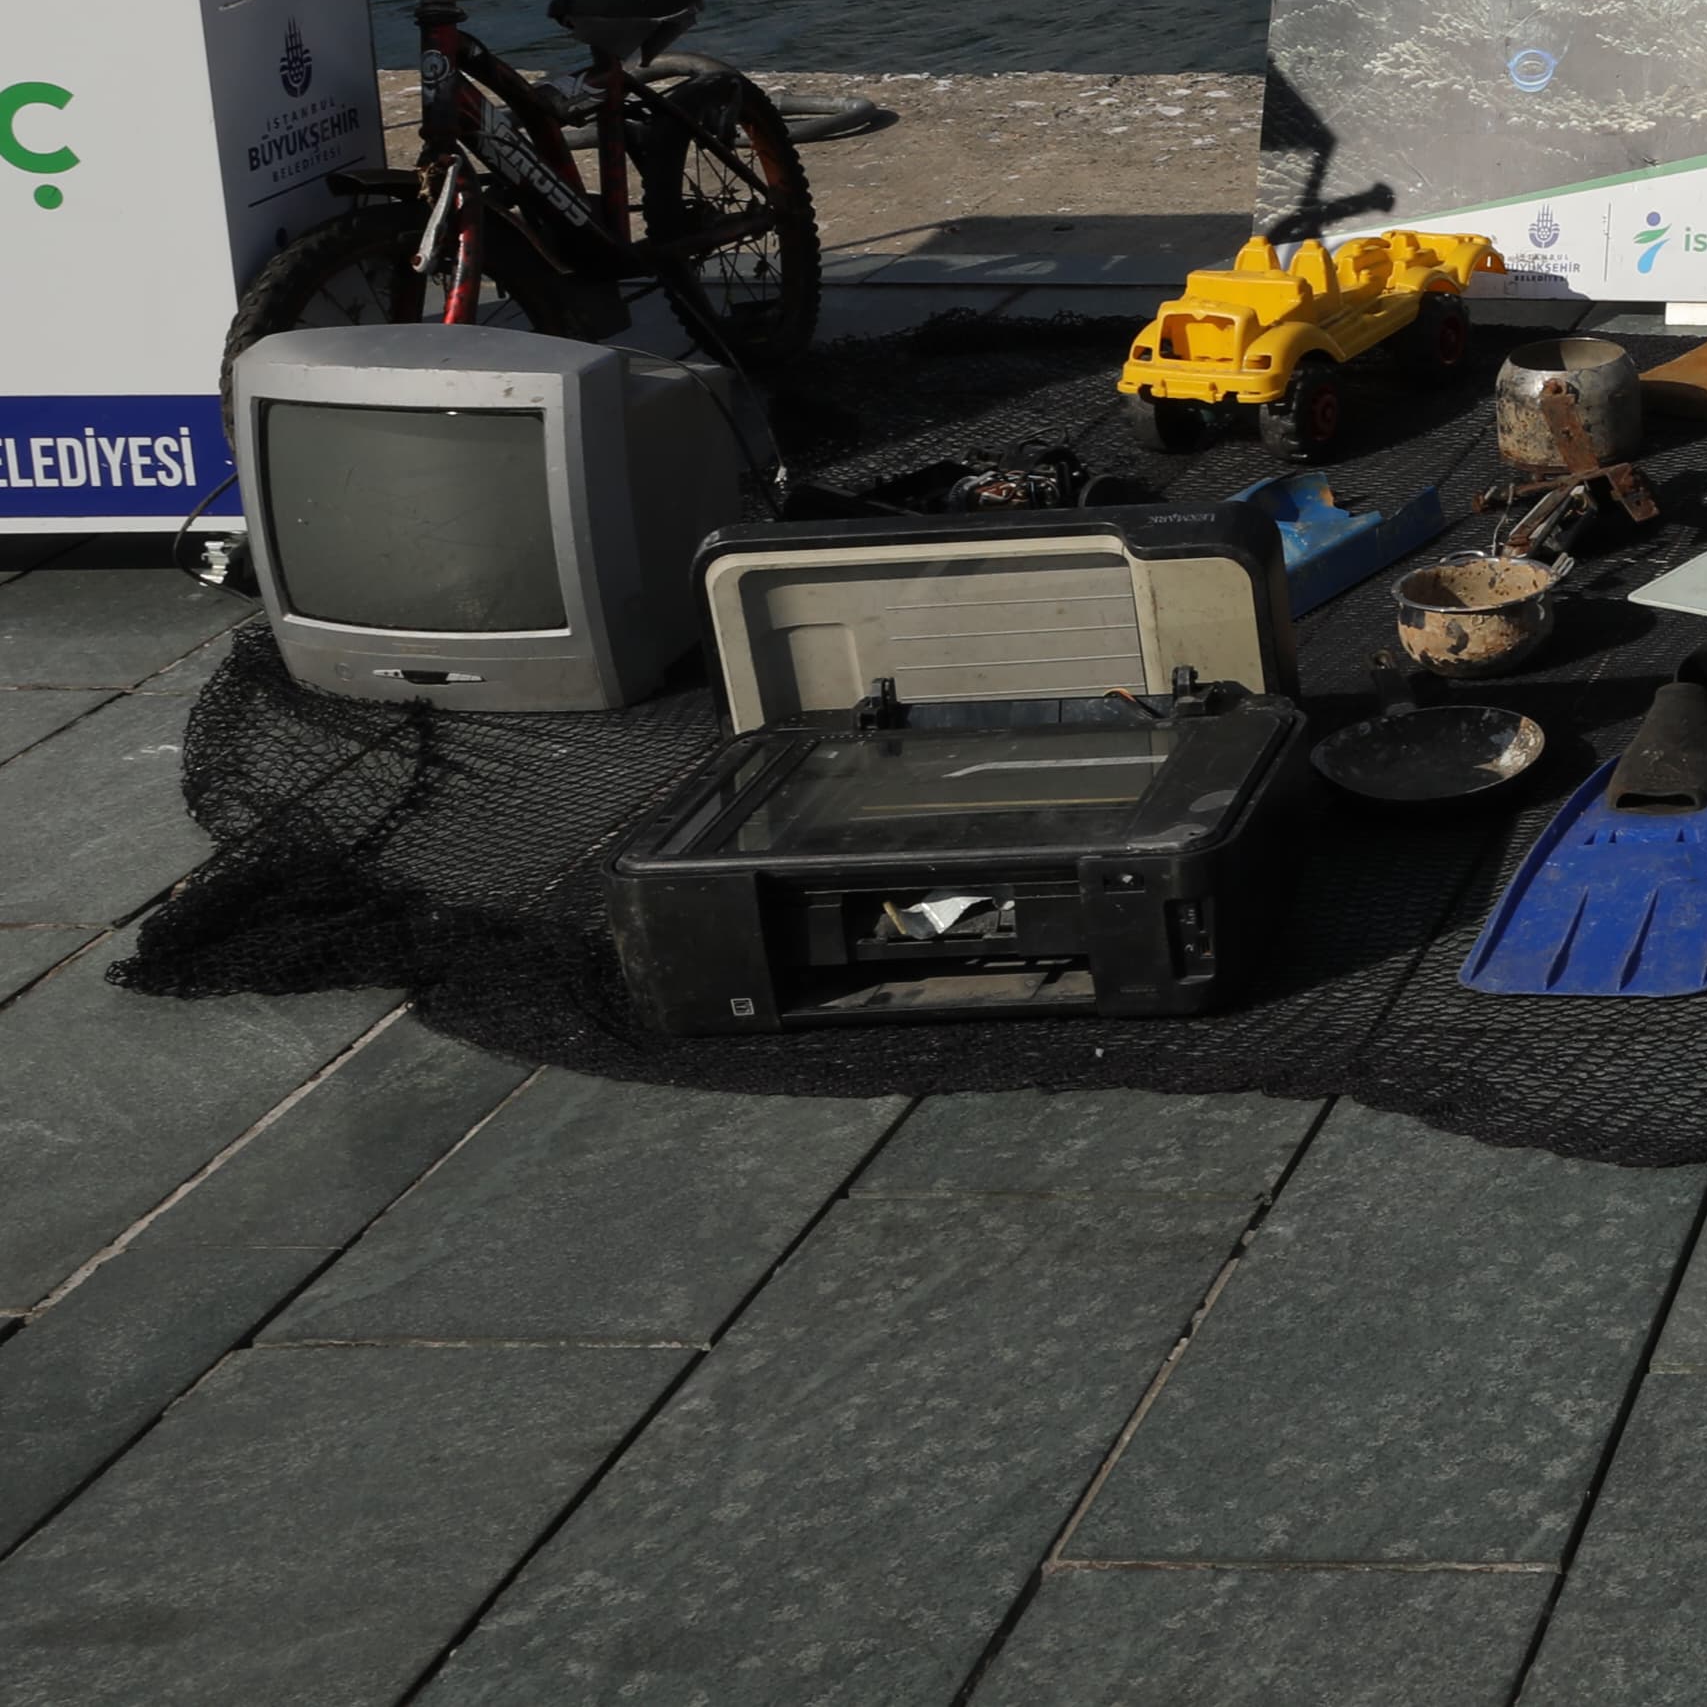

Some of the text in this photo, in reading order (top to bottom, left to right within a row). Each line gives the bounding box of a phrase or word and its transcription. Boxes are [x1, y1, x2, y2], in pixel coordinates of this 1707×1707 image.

[247, 104, 361, 172] BÜYÜKŞEHİR
[266, 96, 337, 132] İSTANBUL
[272, 147, 341, 182] BELEDİYESİ
[0, 426, 197, 488] LEDİYESİ
